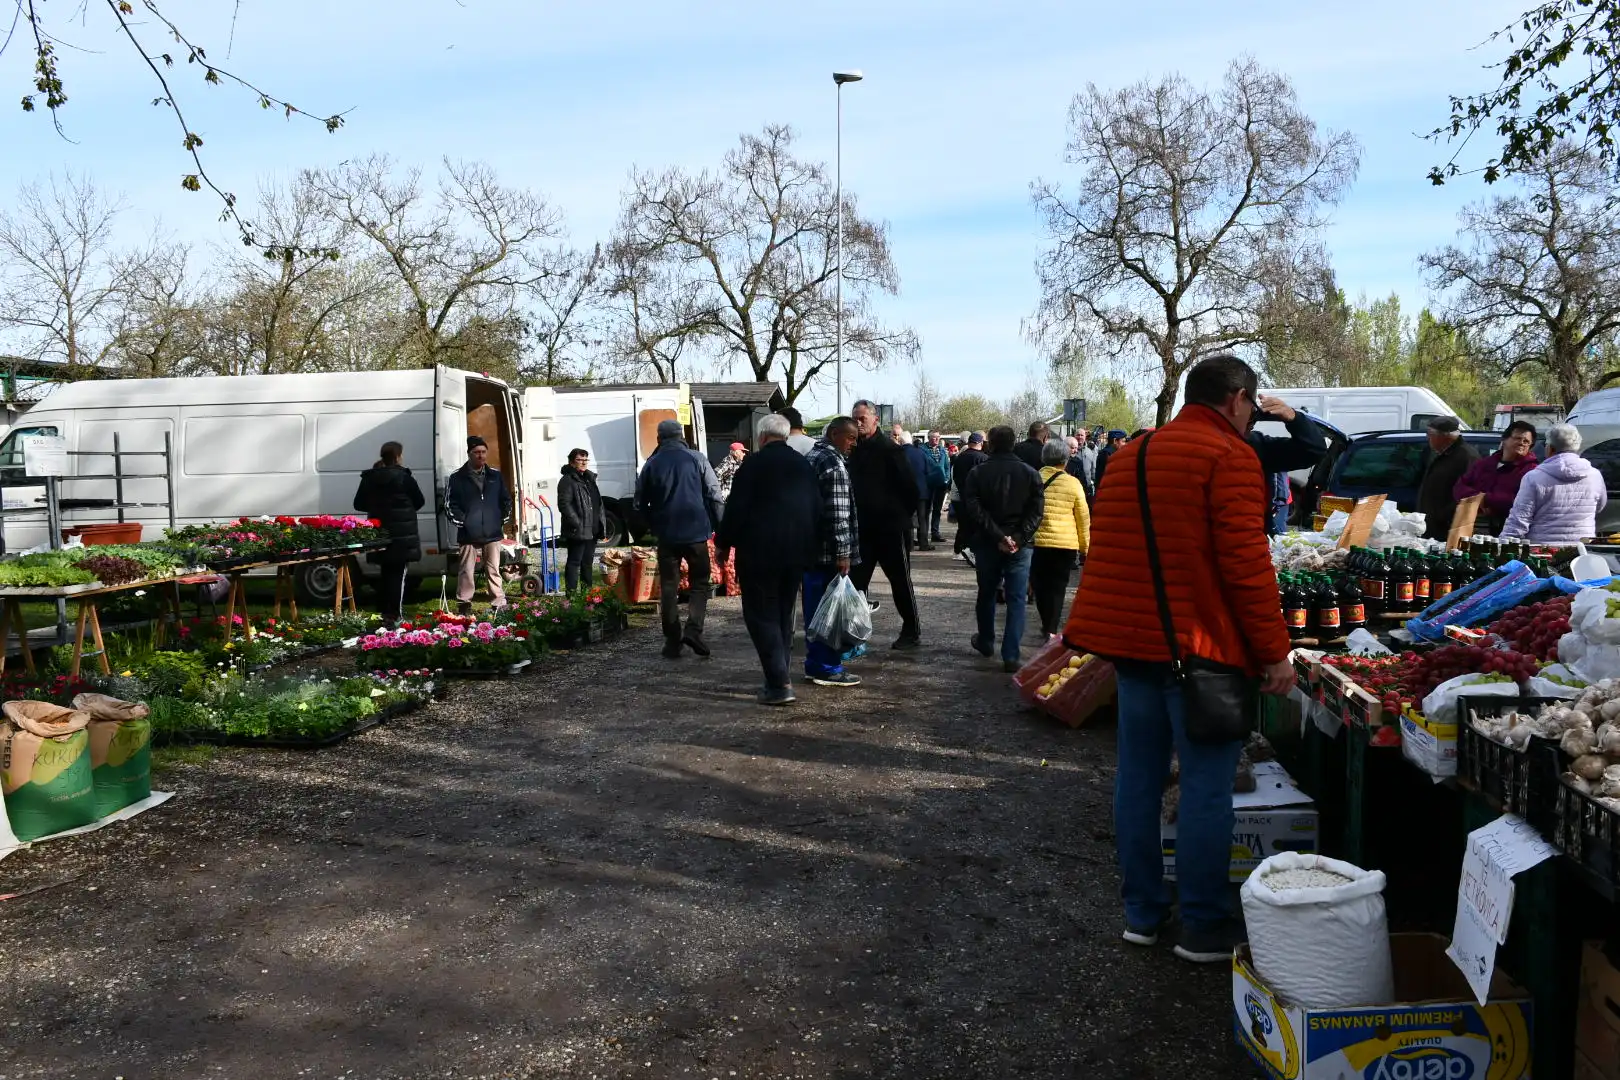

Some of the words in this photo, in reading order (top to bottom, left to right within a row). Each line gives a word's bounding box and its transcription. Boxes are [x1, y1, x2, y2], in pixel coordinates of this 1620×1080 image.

[1309, 1014, 1386, 1031] BANANAS
[1390, 1009, 1463, 1027] PREMIUM
[1398, 1036, 1442, 1047] QUALITY
[1372, 1053, 1467, 1080] derby
